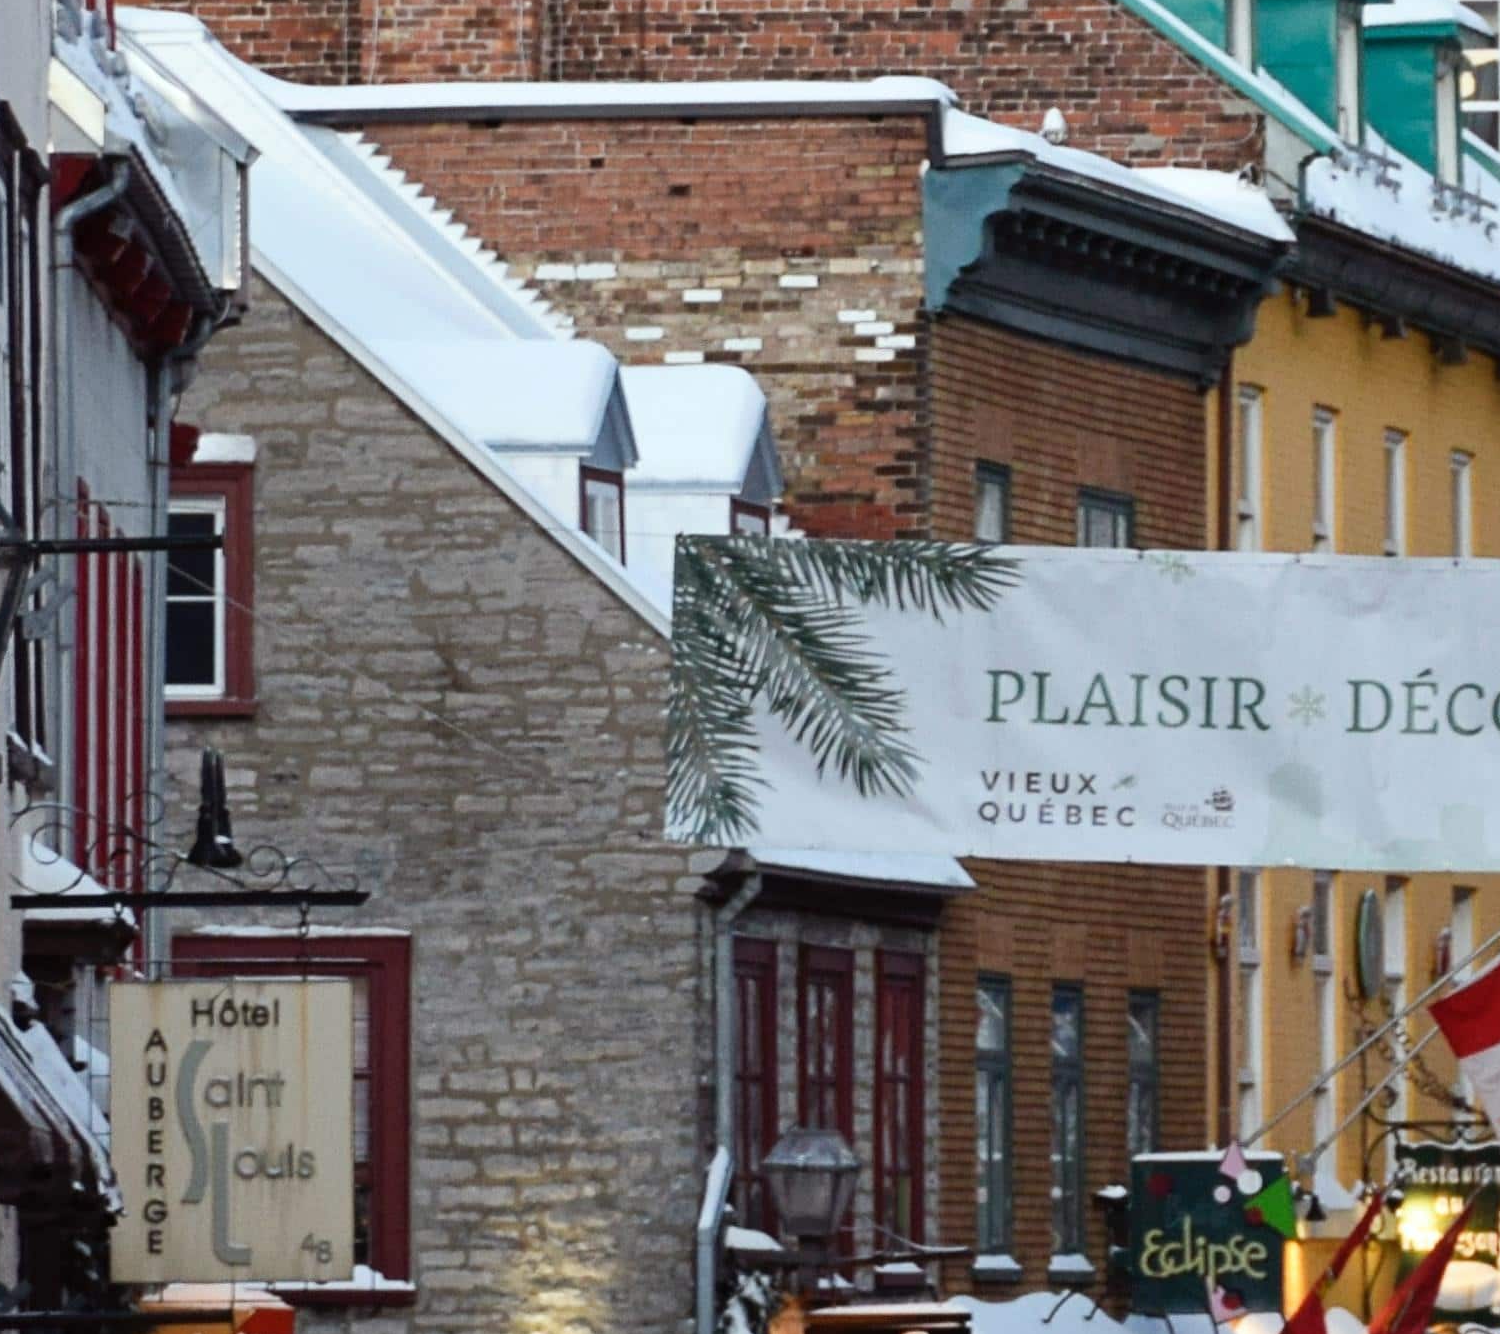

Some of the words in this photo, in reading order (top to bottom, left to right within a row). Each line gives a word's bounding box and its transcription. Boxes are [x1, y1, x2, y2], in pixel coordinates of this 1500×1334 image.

[985, 669, 1271, 731] PLAISIR
[977, 798, 1136, 827] QUÉBEC
[981, 771, 1097, 795] VIEUX
[191, 999, 280, 1028] Hôtel
[144, 1028, 168, 1255] AUBERGE
[175, 1040, 285, 1204] Saint
[211, 1122, 316, 1266] Louis
[300, 1233, 333, 1264] 48
[1140, 1215, 1268, 1285] Eclipse
